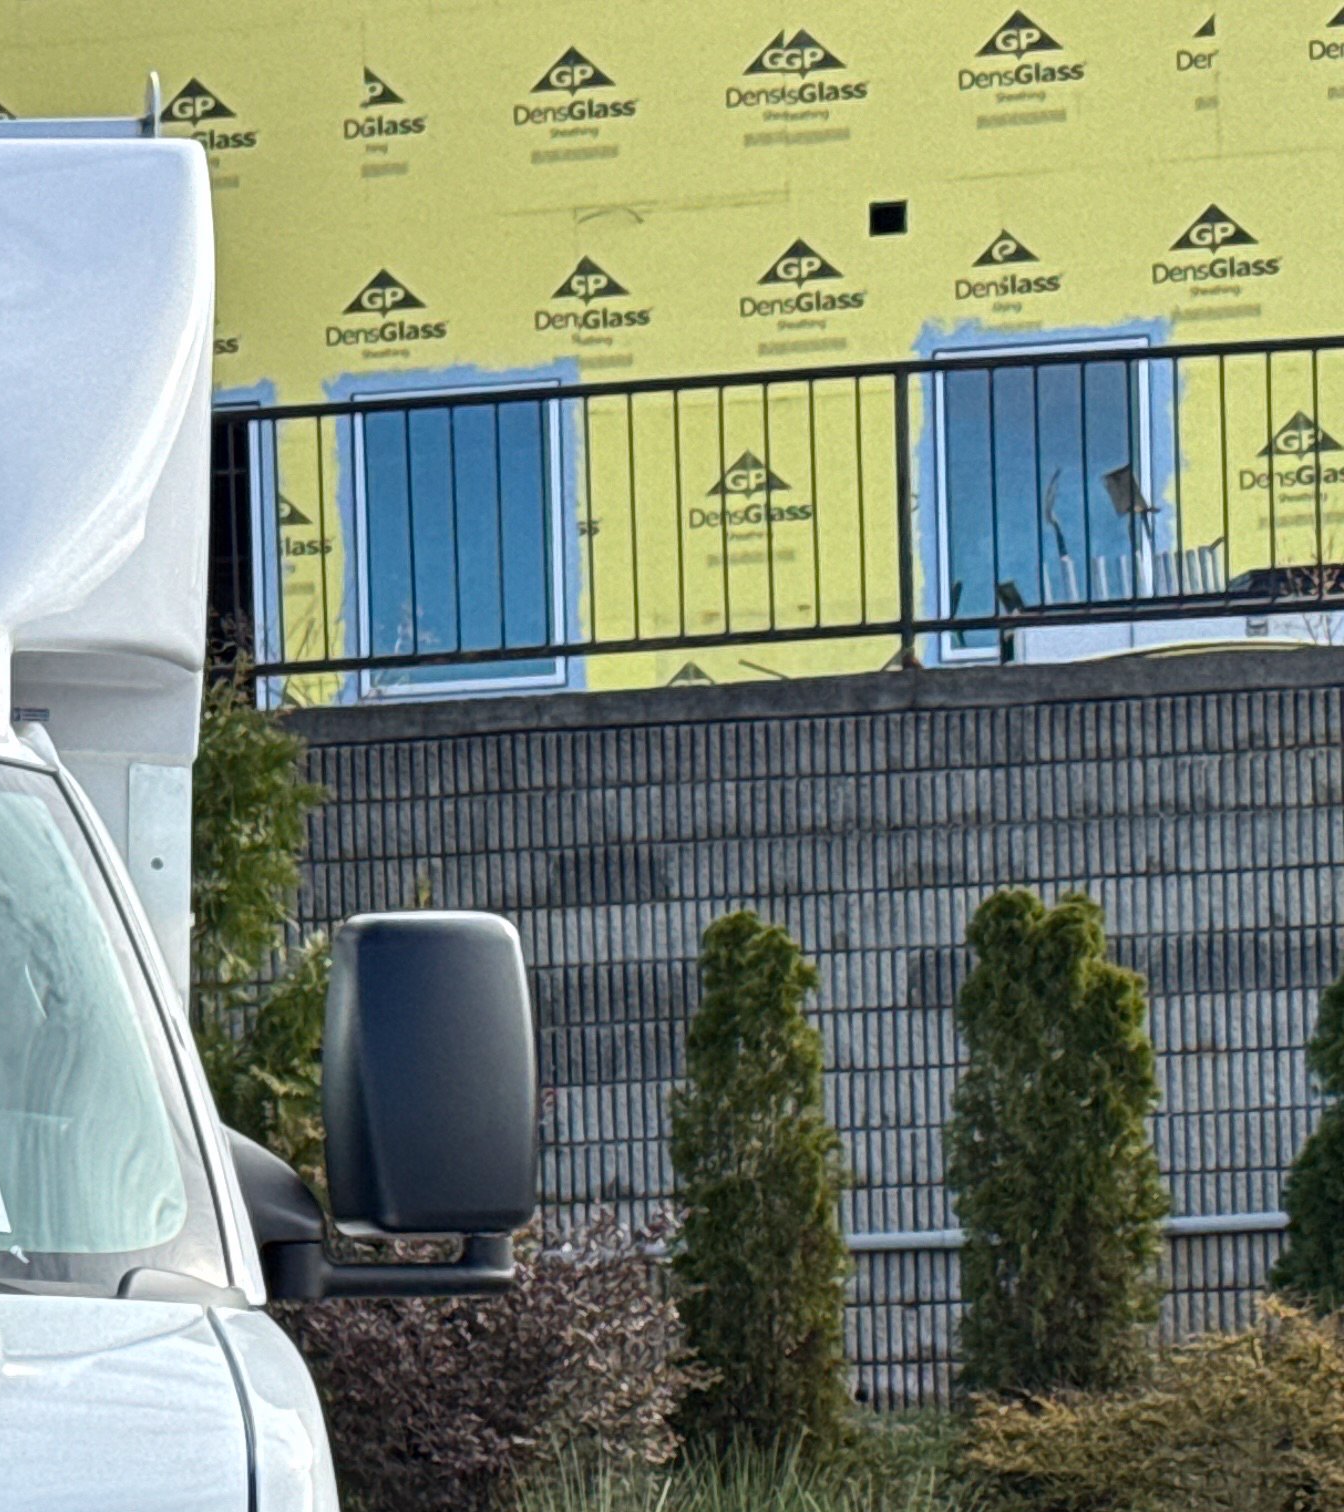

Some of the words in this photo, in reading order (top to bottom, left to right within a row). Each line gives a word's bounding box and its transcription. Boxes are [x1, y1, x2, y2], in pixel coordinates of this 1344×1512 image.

[996, 28, 1041, 51] GP
[550, 64, 594, 87] GP
[958, 62, 1085, 91] DensGlass
[172, 95, 216, 118] GP
[513, 98, 638, 126] DensGlass
[1189, 221, 1236, 245] GP
[776, 257, 821, 280] GP
[1152, 256, 1281, 285] DensGlass
[360, 286, 405, 309] GP
[739, 290, 866, 318] DensGlass
[325, 320, 448, 347] DensGlass
